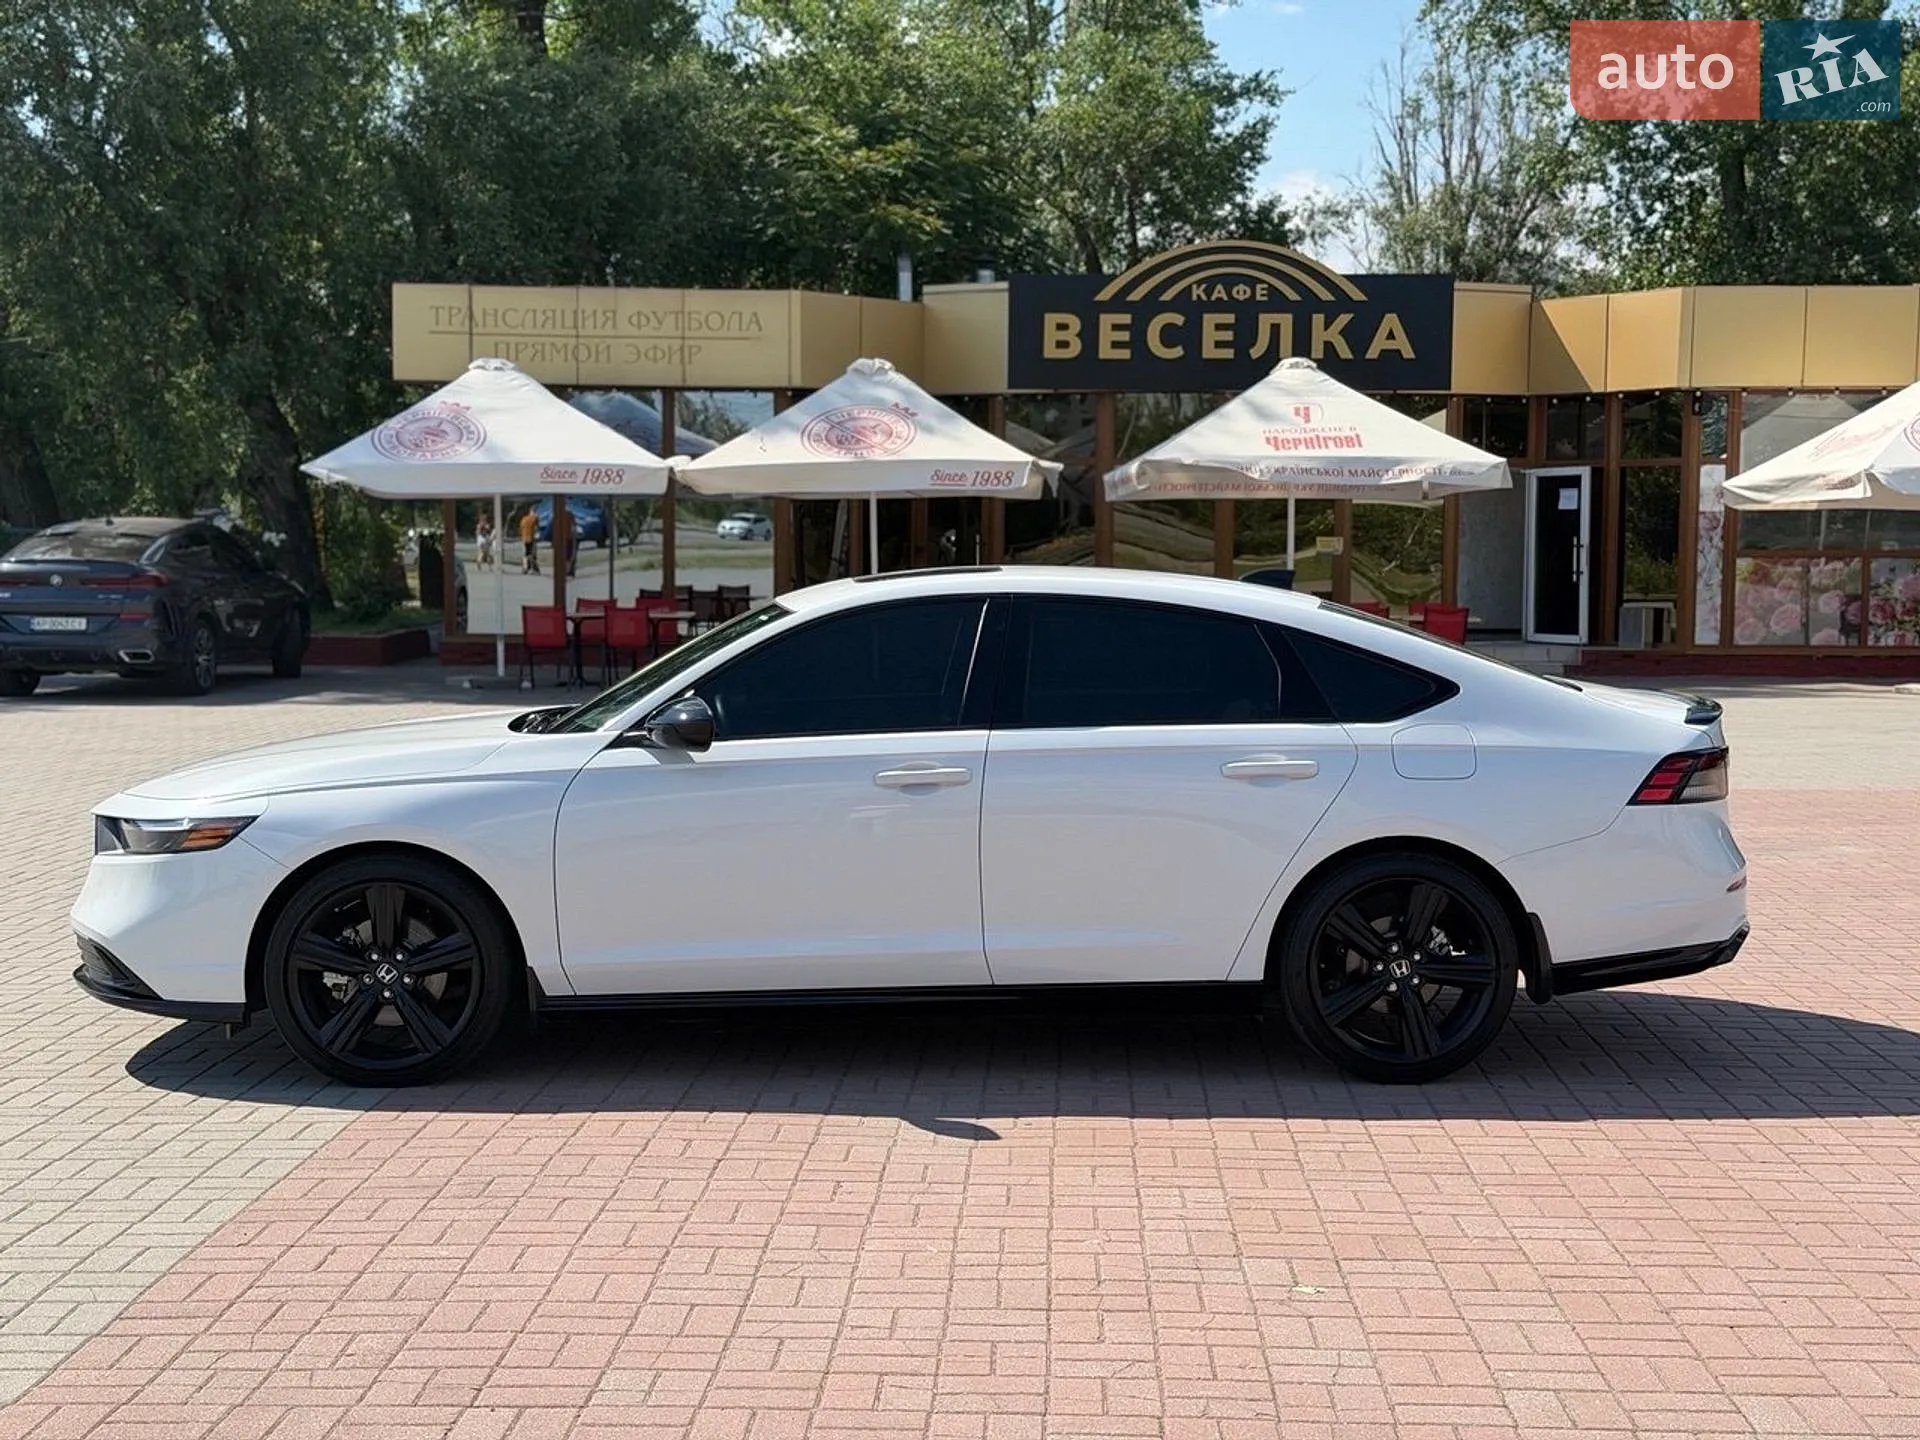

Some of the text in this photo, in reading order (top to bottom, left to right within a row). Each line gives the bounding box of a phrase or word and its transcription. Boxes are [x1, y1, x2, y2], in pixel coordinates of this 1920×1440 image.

[1191, 283, 1270, 301] КАФЕ
[429, 305, 763, 333] ТРАНСЛЯЦИЯ ФУТБОЛА
[1043, 312, 1417, 360] ВЕСЕЛКА
[493, 341, 702, 366] ПРЯМОЙ ЭФИР
[540, 466, 625, 485] Since 1988
[930, 469, 1015, 487] Since 1988
